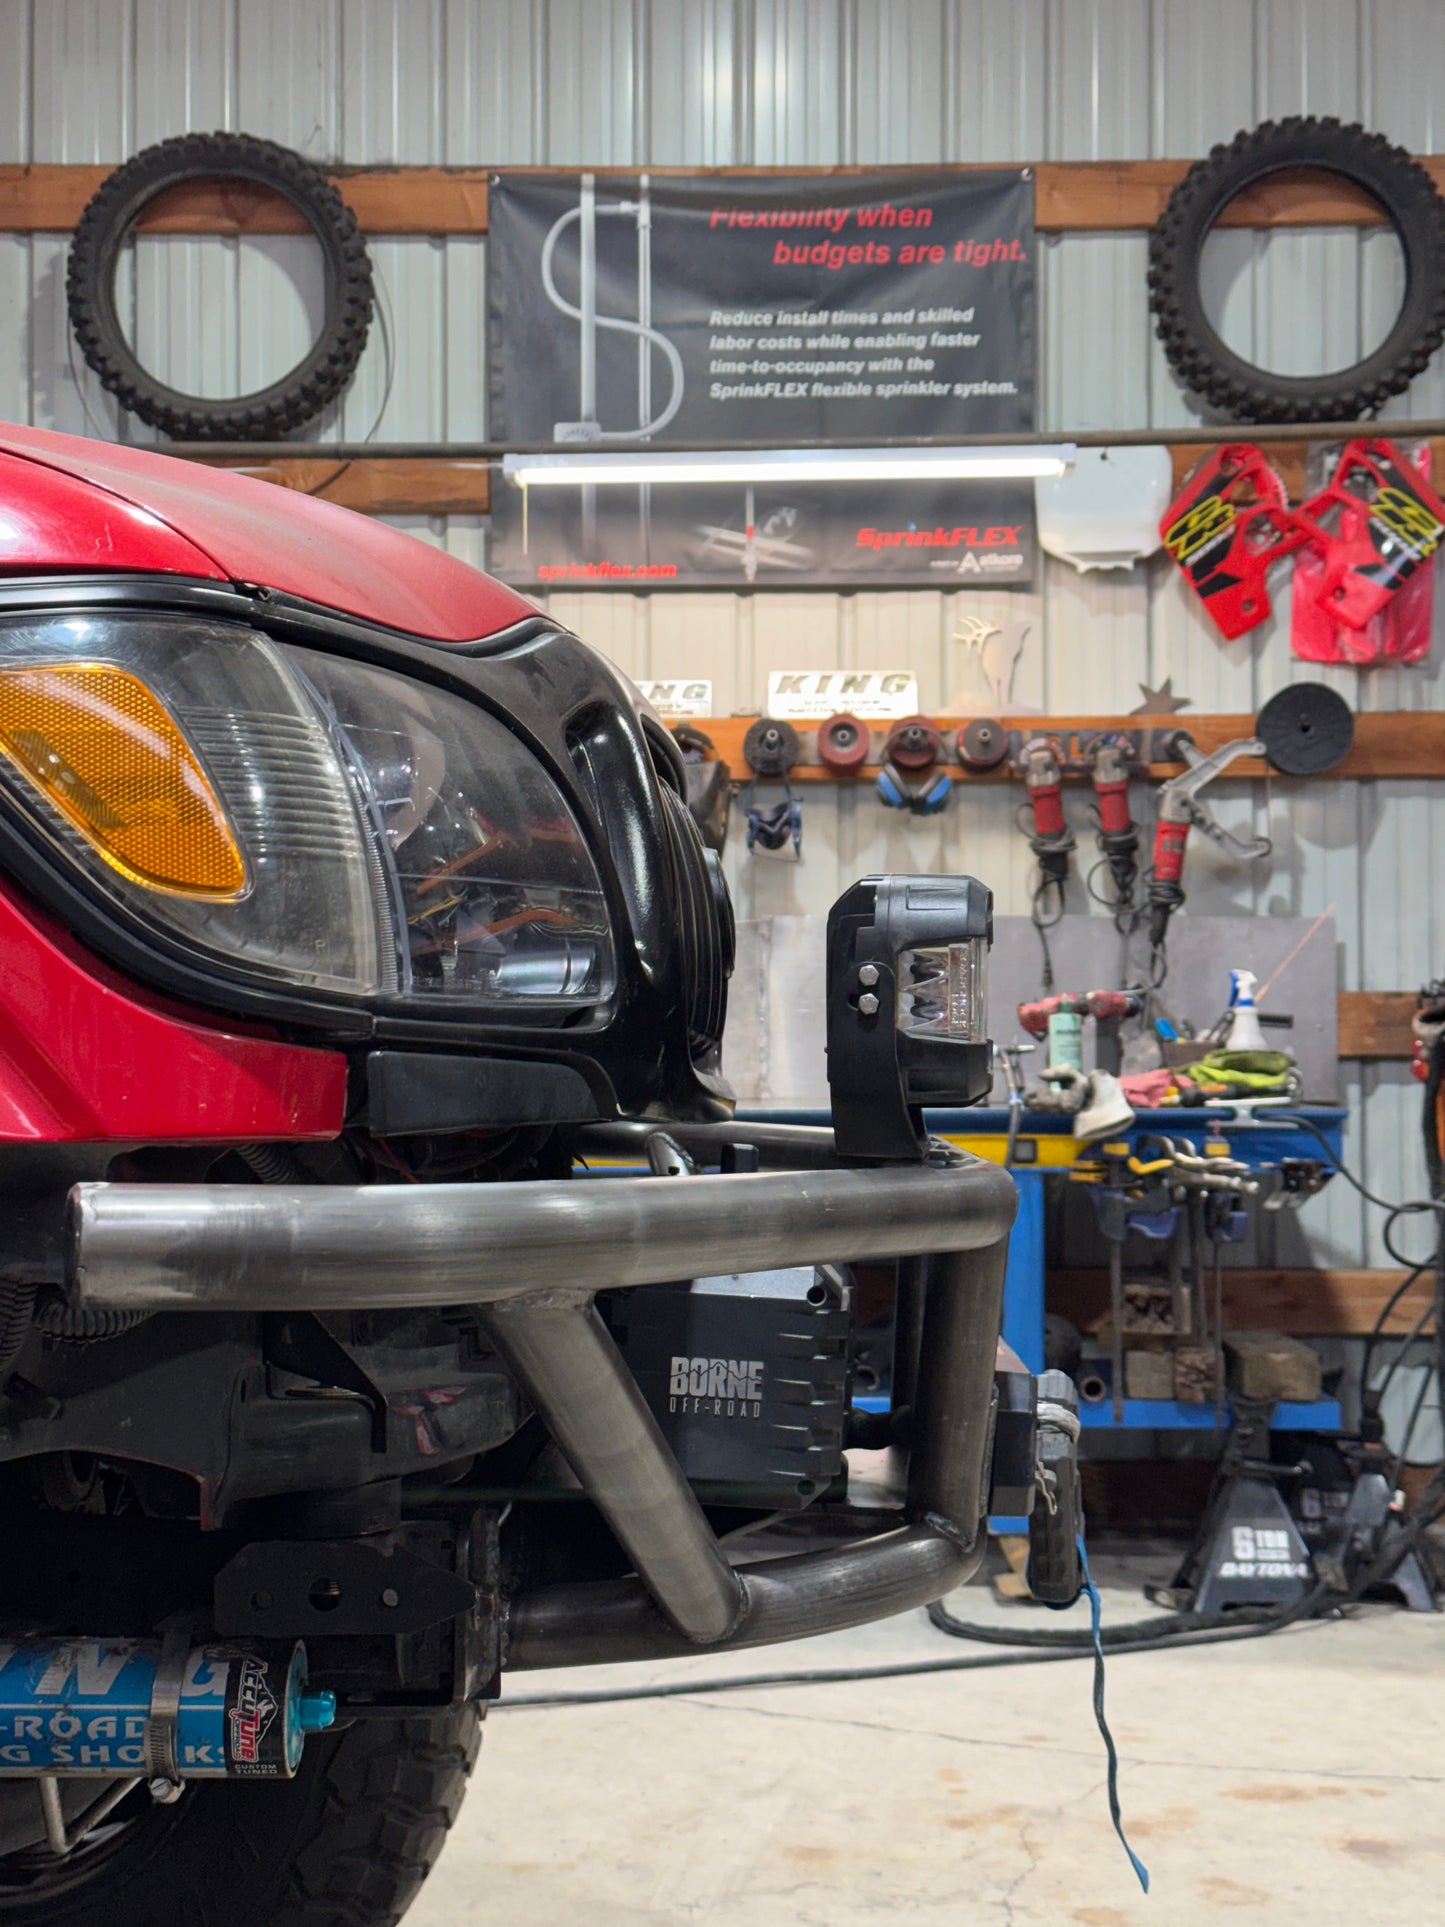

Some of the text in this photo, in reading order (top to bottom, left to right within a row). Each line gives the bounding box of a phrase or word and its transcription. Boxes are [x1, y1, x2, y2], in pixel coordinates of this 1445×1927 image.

[857, 203, 933, 227] when
[773, 239, 1026, 270] budgets are tight.
[709, 306, 975, 326] Reduce install times and skilled
[709, 331, 982, 350] labor costs while enabling faster
[709, 356, 935, 376] time-to-occupancy with the
[709, 380, 1018, 400] SprinkFLEX flexible sprinkler system.
[856, 525, 1022, 552] SprinkFLEX
[538, 562, 677, 581] sprinkflex.com
[639, 683, 708, 700] NG
[775, 674, 911, 695] KING
[670, 1356, 764, 1400] BORNE
[669, 1397, 760, 1418] OFF-ROAD
[1231, 1526, 1256, 1561] 6
[50, 1745, 224, 1763] SHOK
